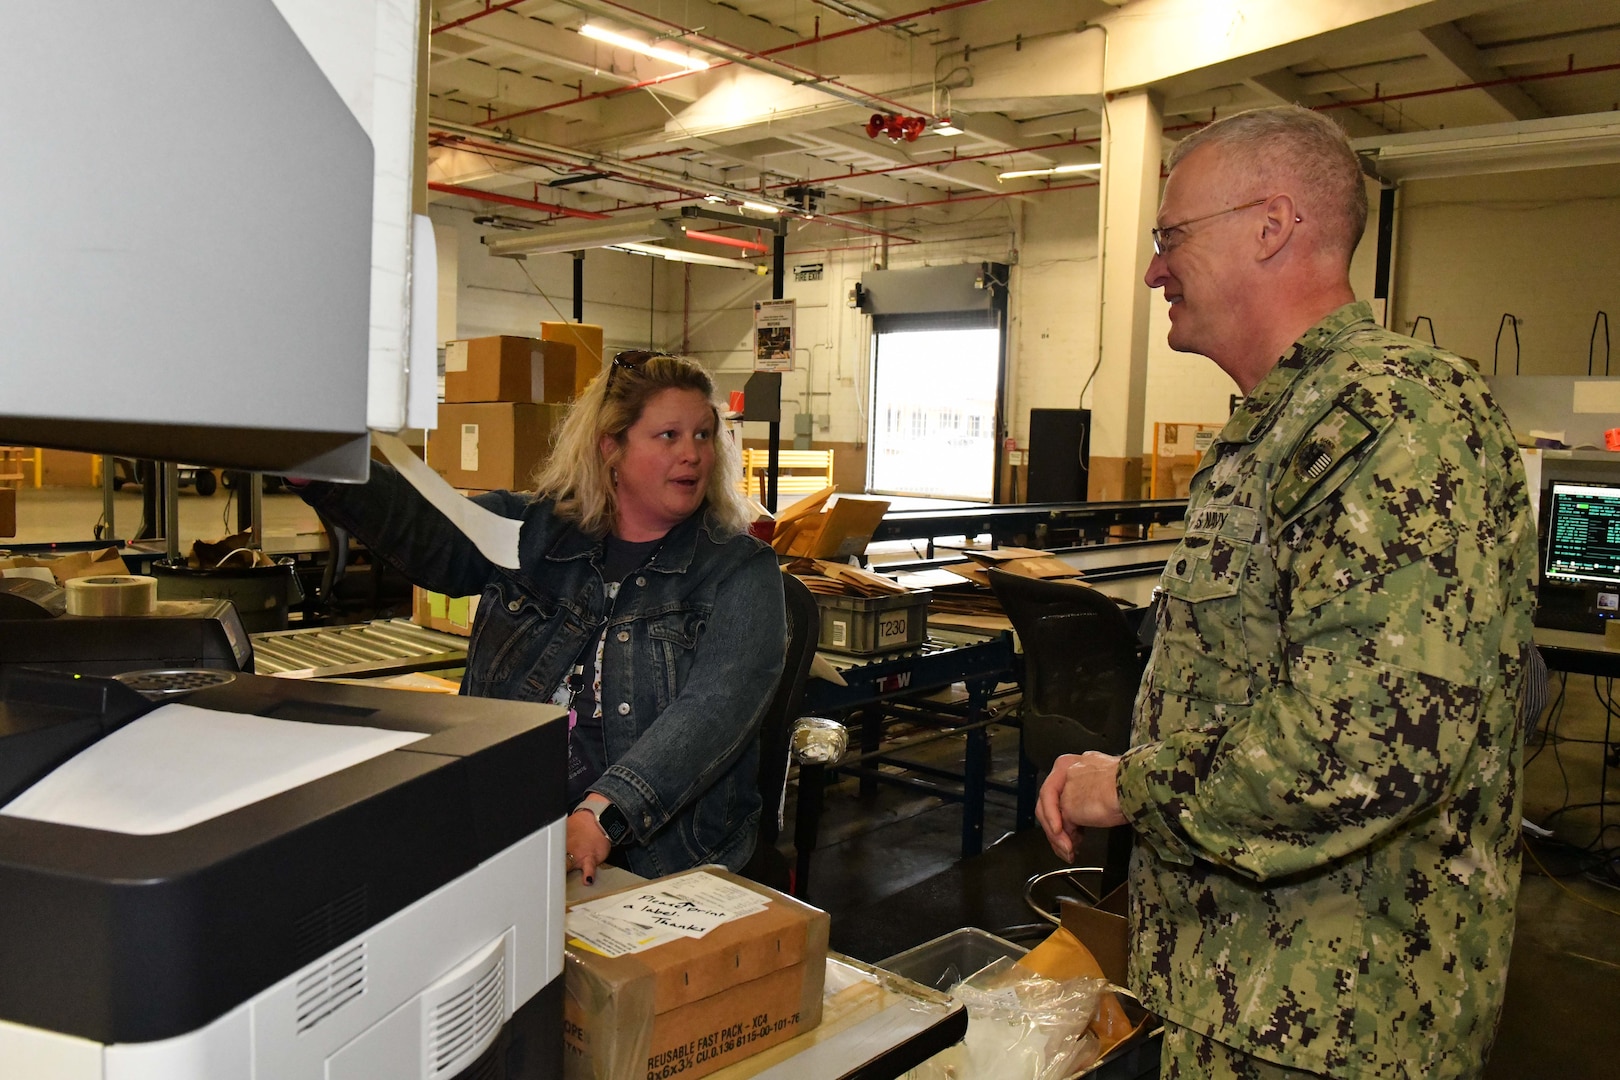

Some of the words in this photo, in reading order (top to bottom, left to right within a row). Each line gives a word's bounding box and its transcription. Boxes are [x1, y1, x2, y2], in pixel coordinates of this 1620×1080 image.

[795, 272, 807, 282] FIRE
[808, 271, 820, 281] EXIT
[1203, 511, 1229, 531] NAVY
[880, 619, 906, 638] T230
[876, 671, 911, 693] TW
[638, 893, 684, 910] Please
[691, 906, 726, 919] print
[651, 915, 707, 933] Thanks
[647, 1040, 695, 1071] REUSABLE
[697, 1032, 720, 1052] FAST
[721, 1023, 743, 1042] PACK
[752, 1013, 768, 1030] XC4
